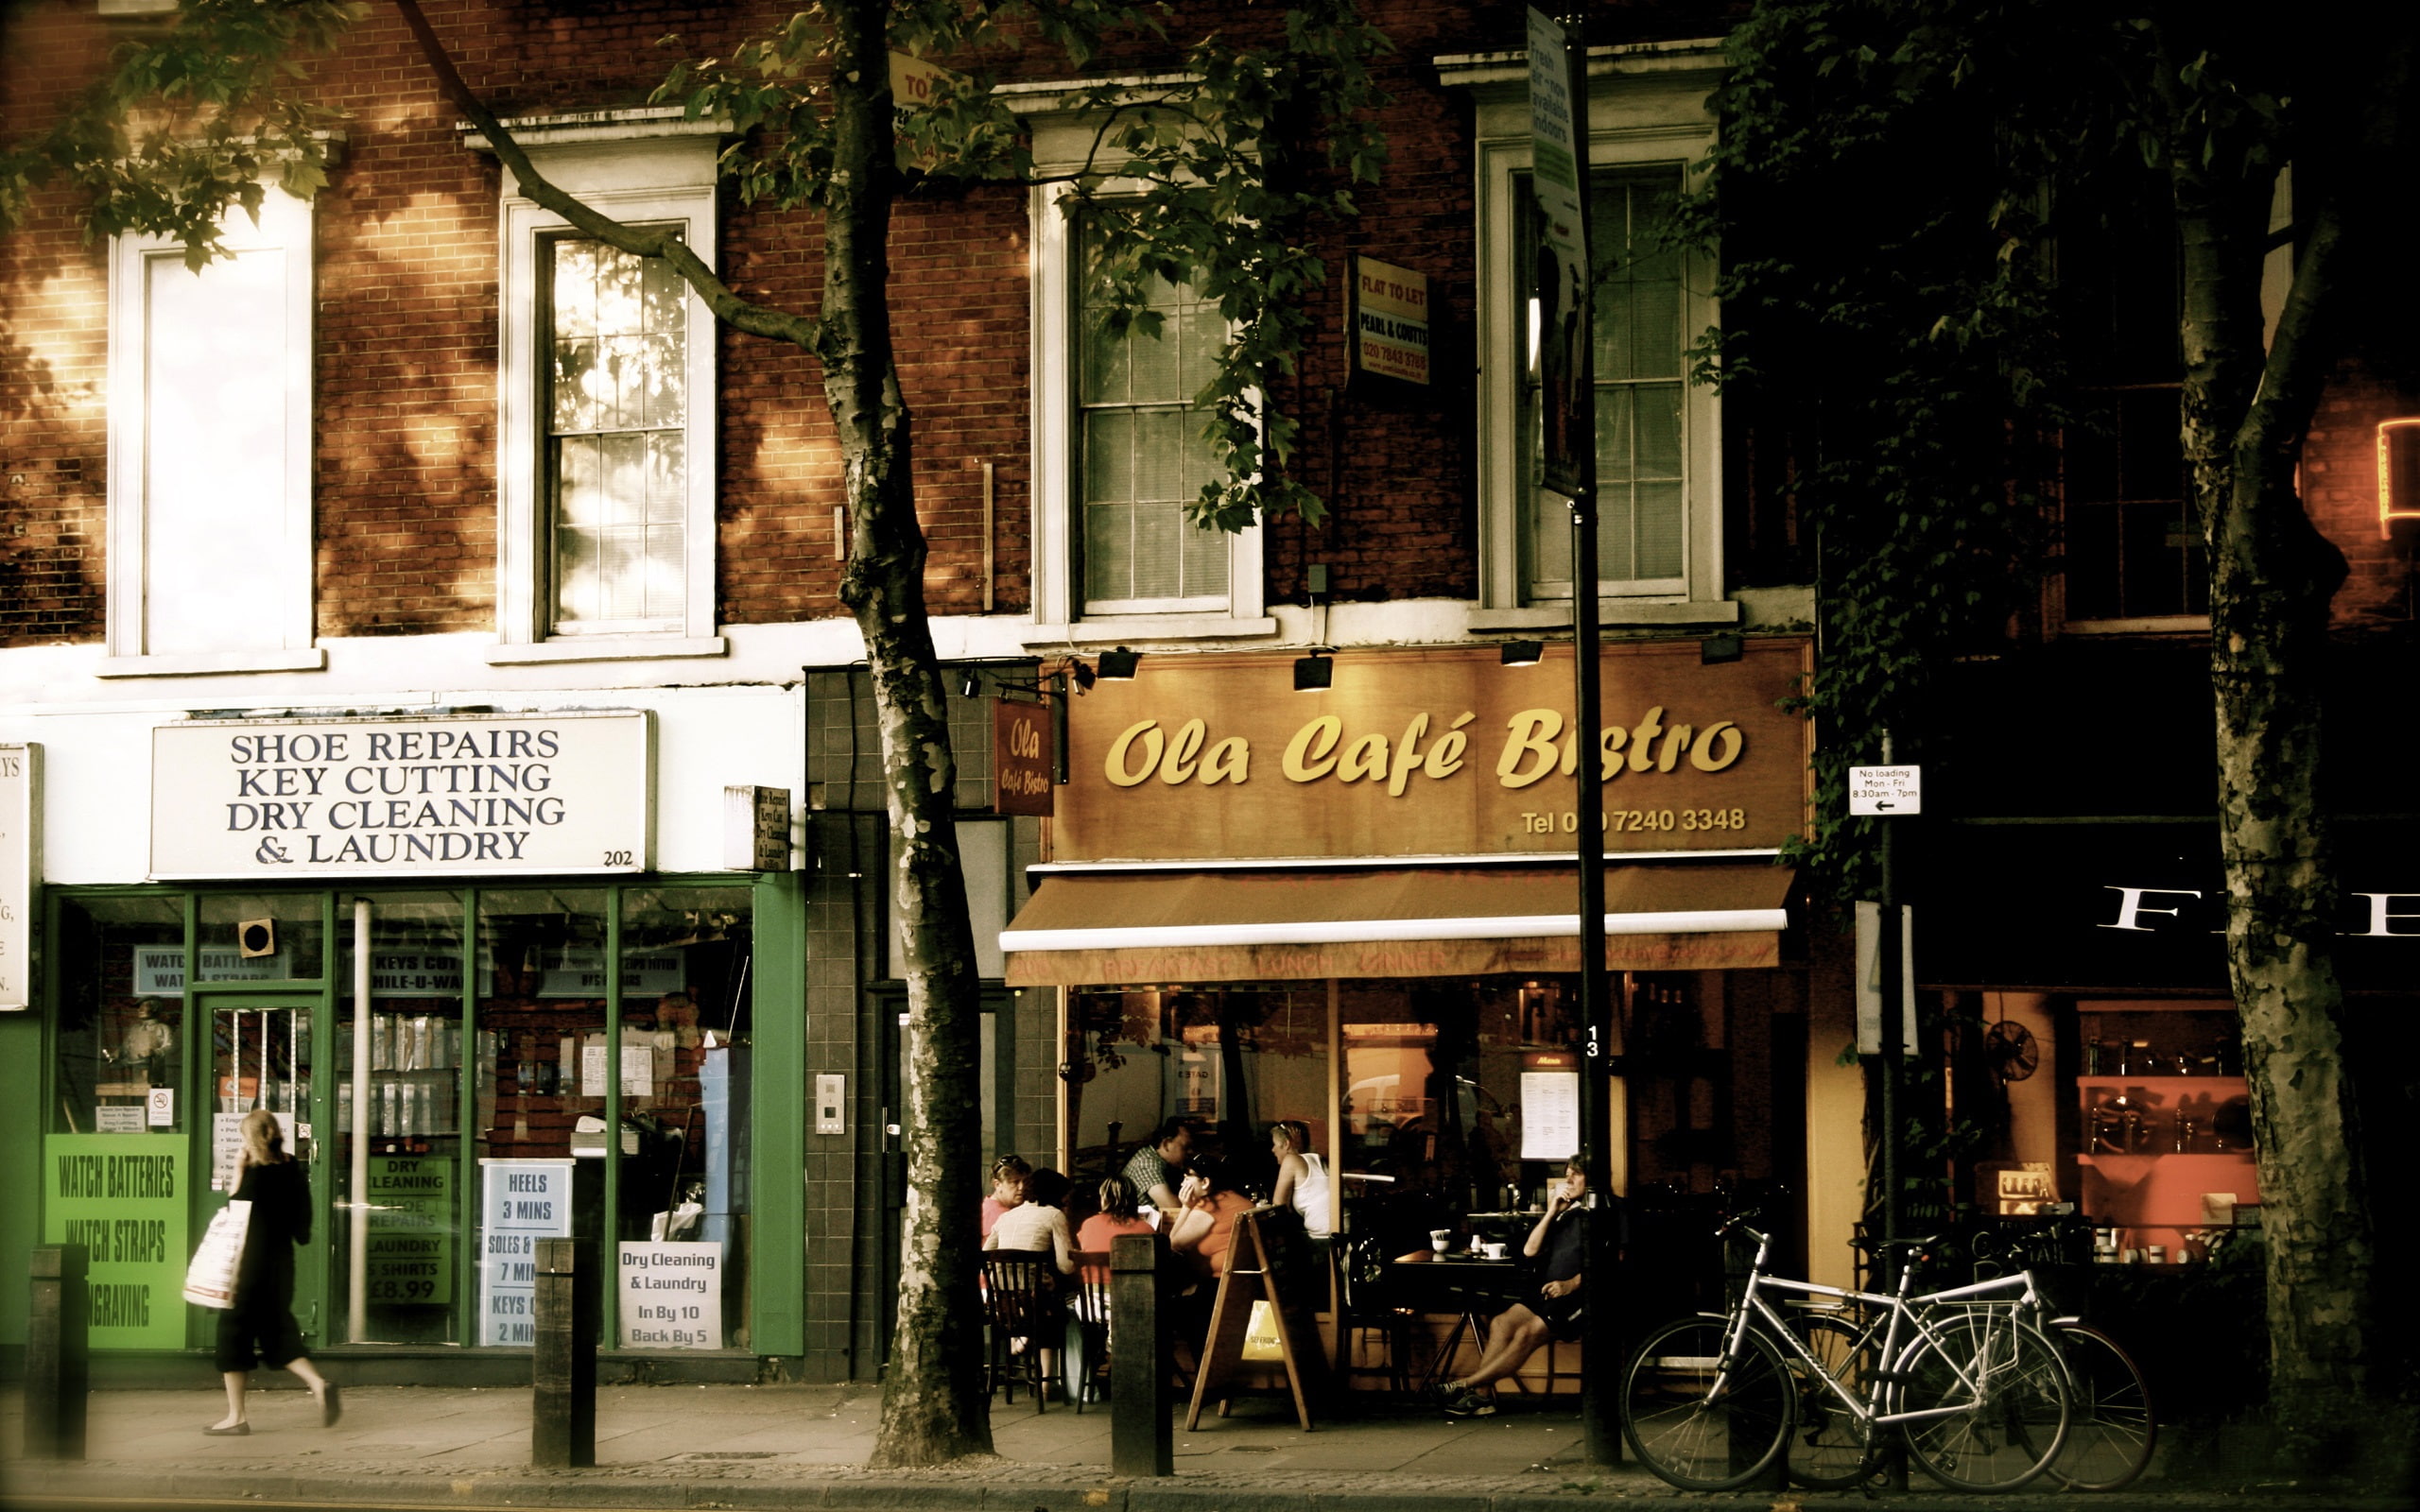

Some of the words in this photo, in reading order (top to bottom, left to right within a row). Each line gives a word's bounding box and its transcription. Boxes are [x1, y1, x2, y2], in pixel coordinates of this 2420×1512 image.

[1530, 41, 1554, 72] Fresh
[905, 74, 928, 99] TO
[1362, 276, 1386, 296] FLAT
[1389, 283, 1404, 301] TO
[1406, 287, 1425, 306] LET
[1360, 313, 1386, 335] PEARL
[1388, 320, 1394, 338] &
[1396, 323, 1427, 346] COUTTS
[231, 733, 349, 765] SHOE
[369, 730, 560, 760] REPAIRS
[1011, 718, 1039, 759] Ola
[1104, 717, 1249, 787] Ola
[1281, 711, 1478, 797] Café
[0, 756, 20, 778] YS
[1876, 769, 1910, 778] loading
[236, 768, 329, 798] KEY
[345, 764, 552, 795] CUTTING
[1001, 768, 1022, 796] Café
[1024, 770, 1049, 795] Bistro
[1897, 789, 1917, 799] 7pm
[227, 802, 312, 833] DRY
[328, 797, 566, 829] CLEANING
[1521, 813, 1555, 833] Tel
[1613, 810, 1675, 832] 7240
[1682, 809, 1745, 831] 3348
[254, 837, 293, 865] &
[307, 832, 530, 863] LAUNDRY
[603, 850, 632, 867] 202
[146, 954, 194, 969] WATC
[375, 955, 418, 970] KEYS
[1254, 952, 1333, 973] LUNCH
[59, 1155, 104, 1198] WATCH
[108, 1155, 174, 1198] BATTERIES
[388, 1160, 420, 1173] DRY
[369, 1176, 443, 1189] LEANING
[509, 1174, 547, 1194] HEELS
[503, 1201, 511, 1220] 3
[517, 1202, 551, 1221] MINS
[114, 1219, 165, 1263] STRAPS
[369, 1240, 441, 1252] AUNDRY
[489, 1235, 520, 1254] SOLES
[523, 1236, 531, 1254] &
[382, 1263, 438, 1276] SHIRTS
[622, 1252, 648, 1269] Dry
[651, 1253, 716, 1270] Cleaning
[501, 1263, 509, 1281] 7
[370, 1280, 435, 1298] £8.99
[631, 1277, 642, 1290] &
[645, 1277, 707, 1294] Laundry
[87, 1284, 149, 1327] NGRAVING
[493, 1296, 526, 1314] KEYS
[638, 1305, 653, 1318] In
[656, 1306, 676, 1322] By
[682, 1306, 700, 1319] 10
[499, 1323, 508, 1342] 2
[631, 1329, 668, 1342] Back
[673, 1329, 693, 1345] By
[698, 1330, 707, 1342] 5
